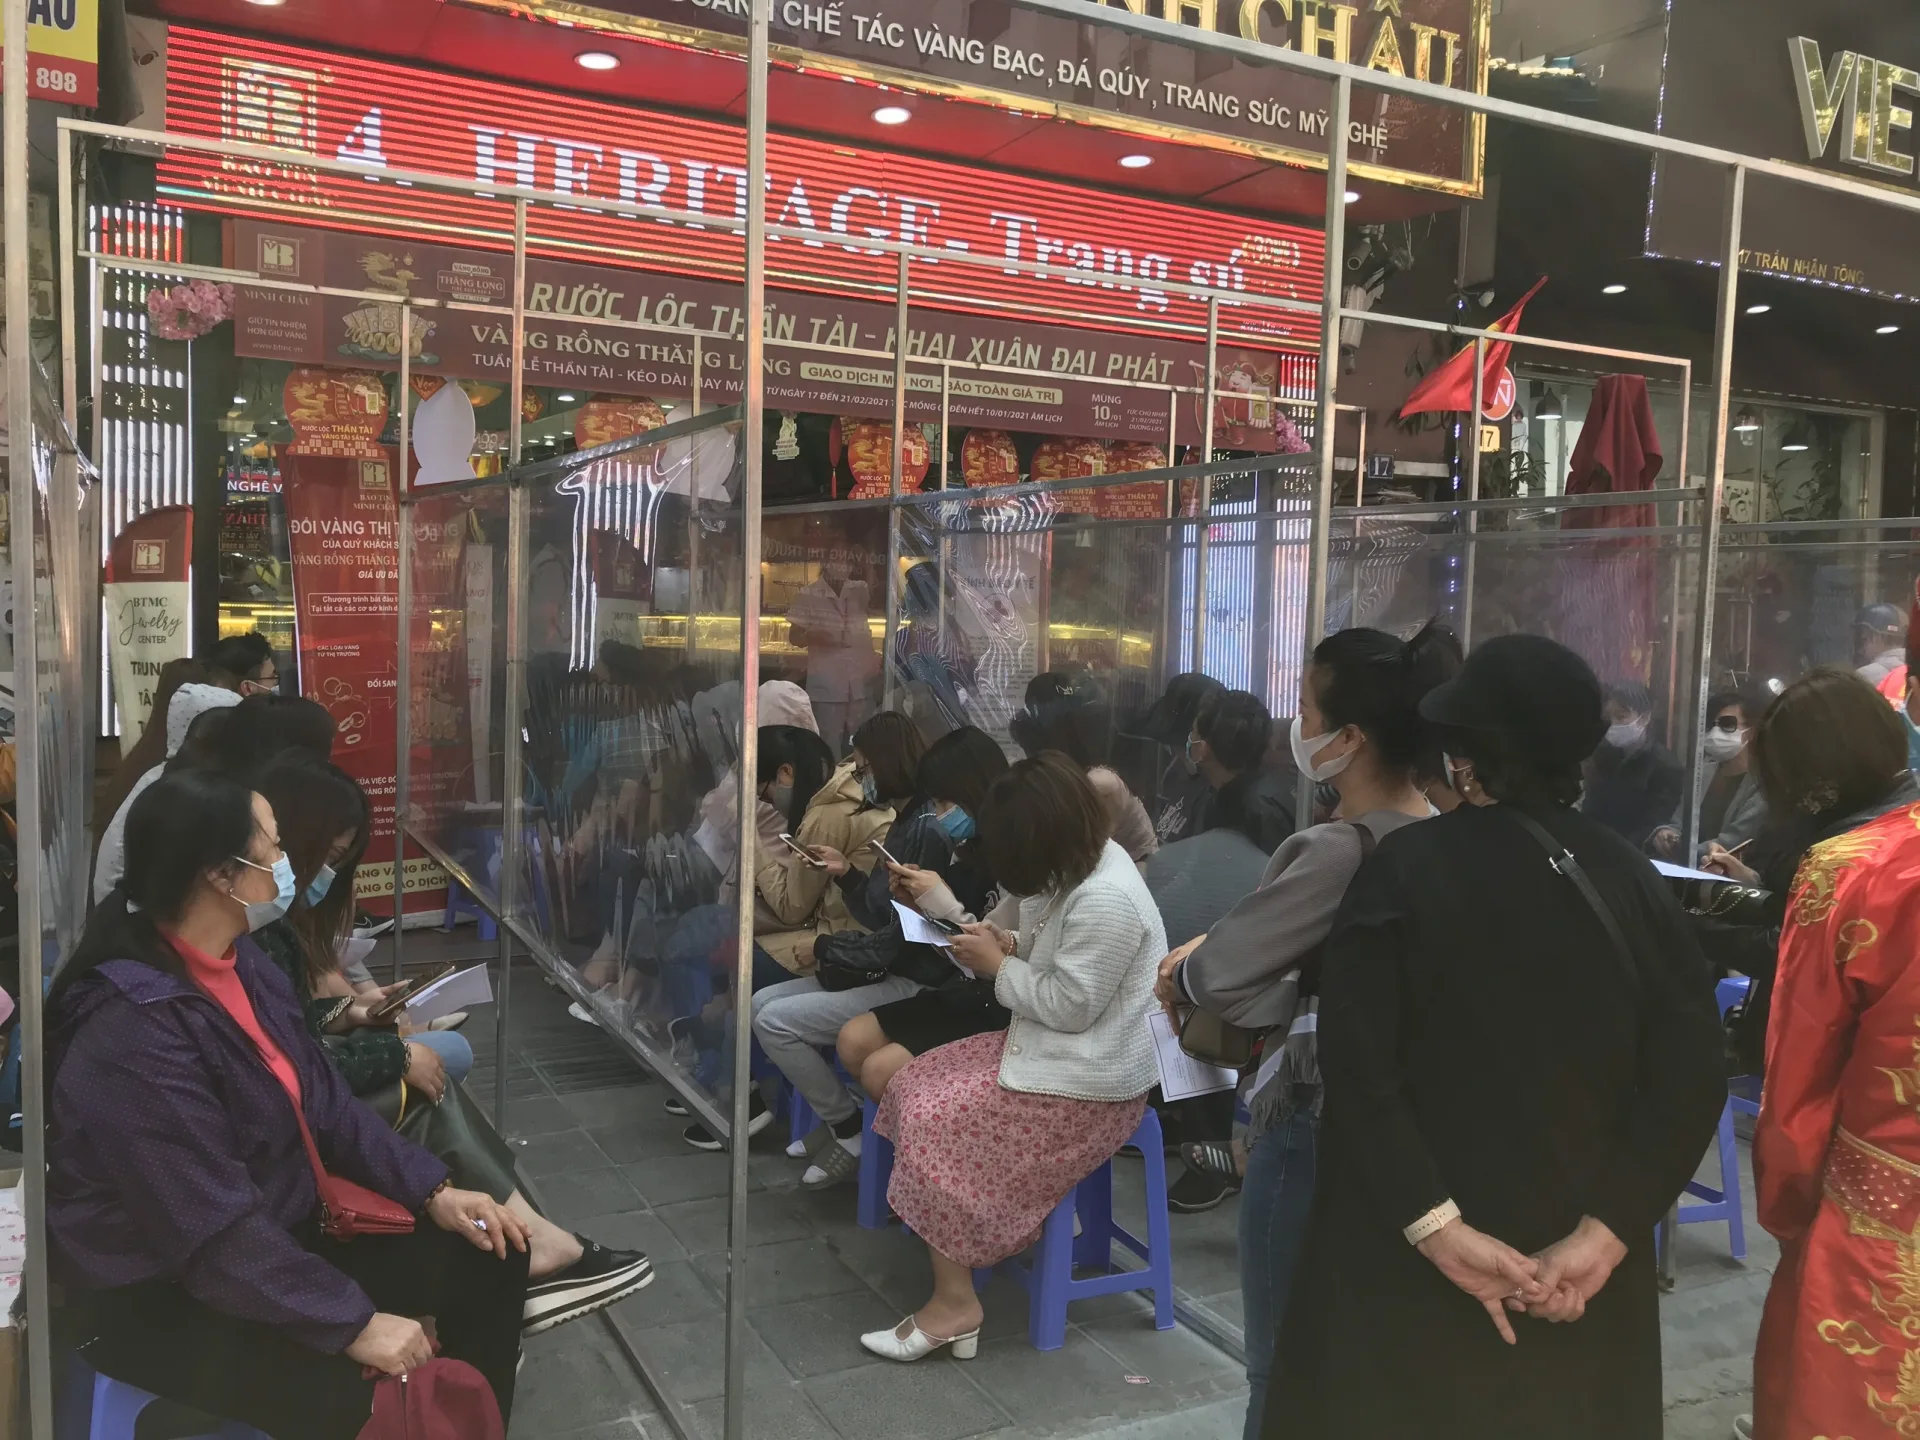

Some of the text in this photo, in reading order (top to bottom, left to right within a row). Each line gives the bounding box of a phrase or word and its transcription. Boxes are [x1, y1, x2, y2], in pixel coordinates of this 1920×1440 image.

[36, 67, 77, 93] 898
[782, 1, 844, 36] CHẾ
[852, 13, 905, 47] TÁC
[914, 23, 985, 64] VÀNG
[1057, 58, 1092, 89] ĐÁ
[1162, 81, 1239, 118] TRANG
[1248, 98, 1291, 129] SỨC
[1299, 110, 1330, 136] MỸ
[1348, 120, 1388, 155] GHỆ
[990, 212, 1172, 312] Trang
[1755, 249, 1789, 272] TRẦN
[1834, 264, 1865, 284] TÔNG
[529, 282, 624, 321] RƯỚC
[809, 313, 858, 348] TÀI
[965, 336, 1042, 369] XUÂN
[1106, 352, 1174, 383] PHÁT
[556, 329, 630, 359] RỒNG
[729, 354, 791, 376] LNG
[522, 355, 540, 372] LỄ
[542, 357, 587, 378] THẦN
[590, 363, 614, 379] TÀI
[626, 367, 657, 383] KÉO
[661, 371, 686, 386] DÀI
[808, 366, 842, 379] GIAO
[847, 370, 878, 384] DỊCH
[909, 378, 934, 389] NƠI
[974, 381, 1009, 396] TOÀN
[1012, 386, 1034, 399] GIÁ
[1035, 389, 1055, 403] TRỊ
[780, 387, 807, 399] NGÀY
[808, 391, 817, 399] 17
[819, 389, 839, 401] ĐẾN
[840, 393, 889, 407] 21/02/2021
[949, 402, 967, 414] ĐẾN
[968, 405, 985, 416] HẾT
[986, 407, 1029, 420] 10/01/2021
[1030, 410, 1044, 421] ÂM
[1045, 412, 1063, 423] LỊCH
[358, 426, 373, 435] TÀI
[1374, 456, 1390, 477] 17
[291, 516, 391, 539] ĐỔI VÀNG THỊ
[322, 539, 341, 549] CỦA
[343, 539, 361, 549] QUÝ
[364, 539, 392, 549] KHÁCH
[293, 552, 321, 565] VÀNG
[324, 552, 353, 565] RỒNG
[355, 552, 391, 566] THĂNG
[358, 568, 374, 579] GIÁ
[133, 596, 168, 608] BTMC
[322, 595, 352, 604] Chương
[311, 604, 322, 613] Tại
[137, 635, 167, 644] CENTER
[130, 661, 163, 677] TRUN
[382, 680, 397, 688] SAN
[371, 776, 387, 786] VIỆC
[354, 868, 380, 879] ANG
[418, 876, 448, 889] DỊCH
